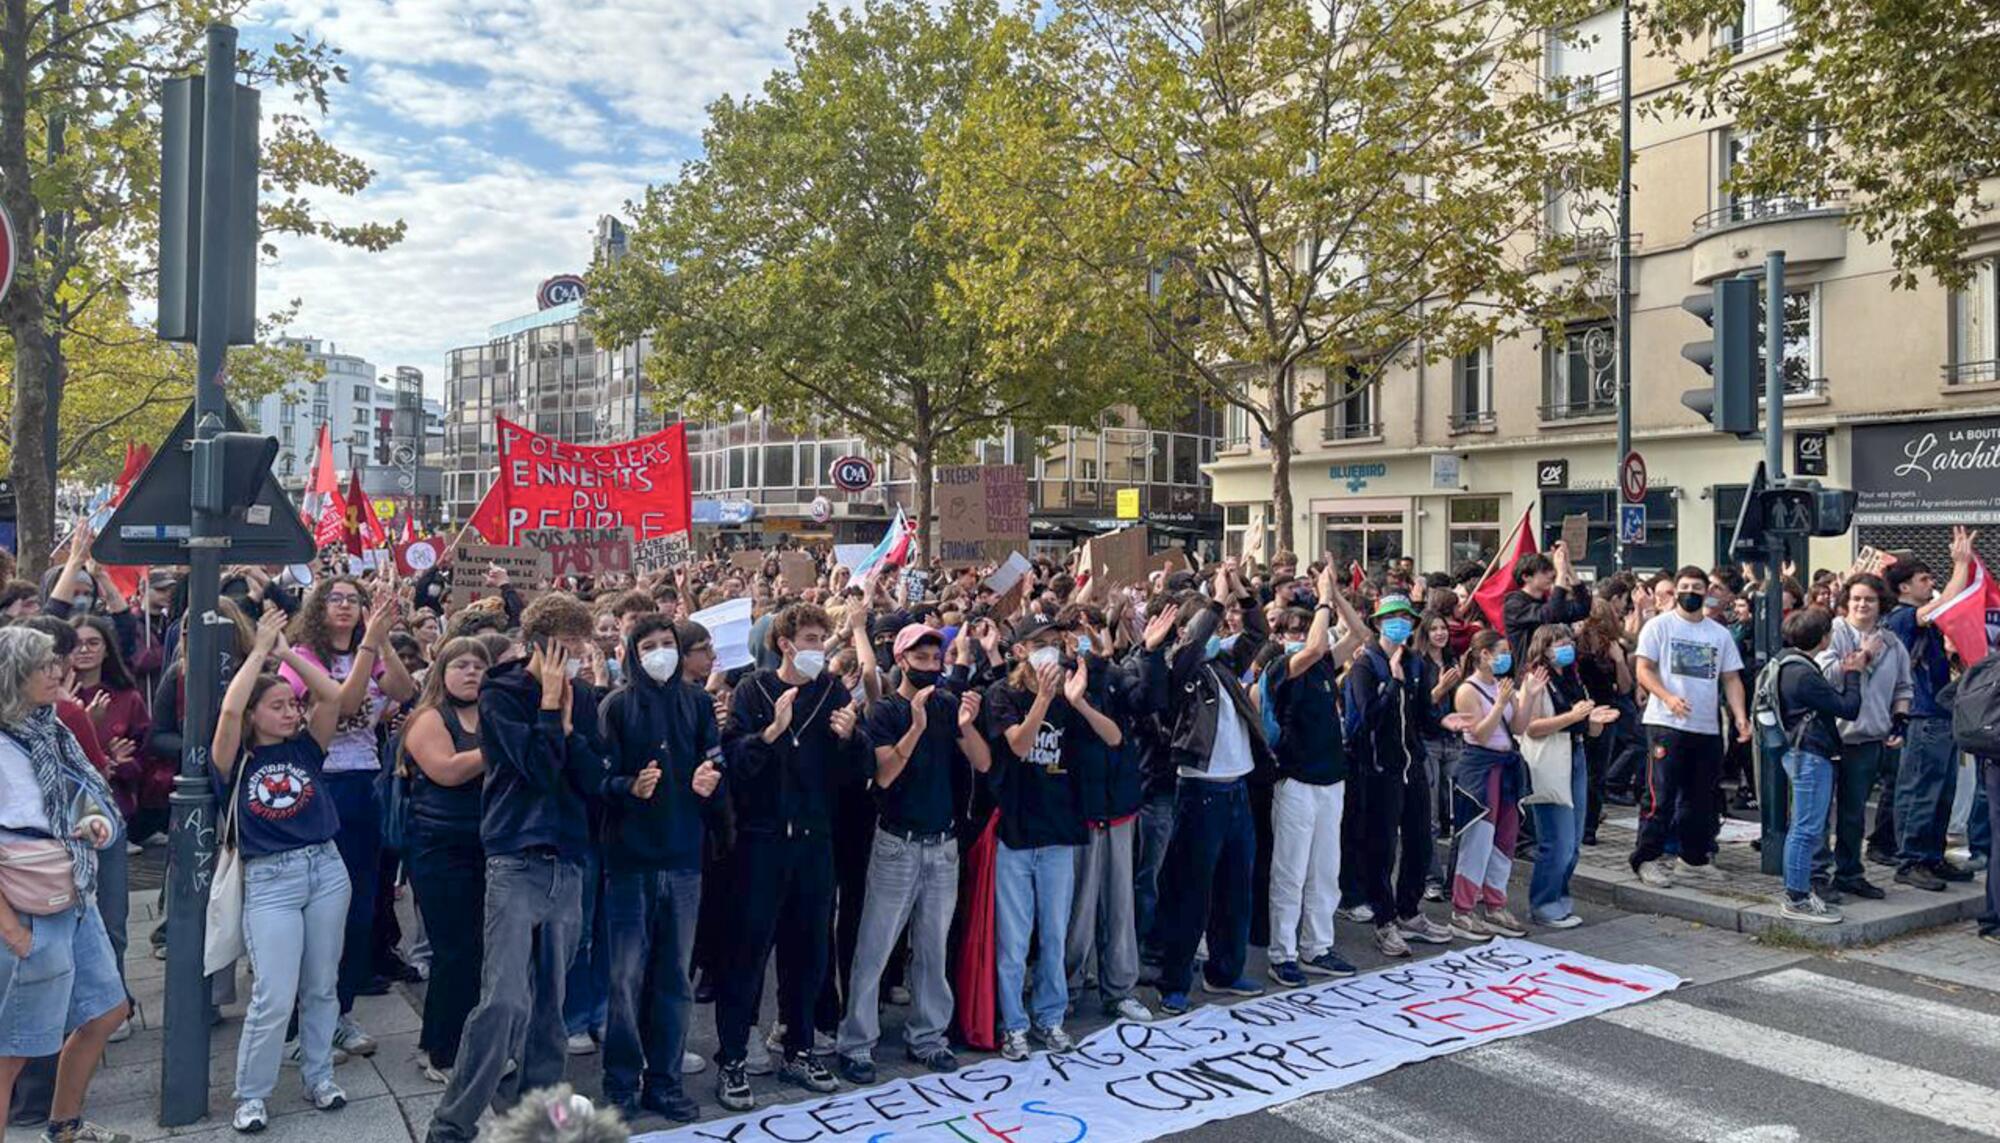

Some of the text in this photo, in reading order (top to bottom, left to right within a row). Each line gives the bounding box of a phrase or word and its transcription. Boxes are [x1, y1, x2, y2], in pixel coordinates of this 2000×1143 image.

[549, 285, 581, 303] C&A
[1949, 431, 1965, 441] LA
[503, 427, 672, 468] POLICIERS
[513, 460, 653, 492] ENNEMIS
[841, 464, 868, 482] C&A
[1329, 464, 1386, 479] BLUEBIRD
[573, 490, 608, 510] DU
[1105, 1036, 1371, 1110] CONTRE
